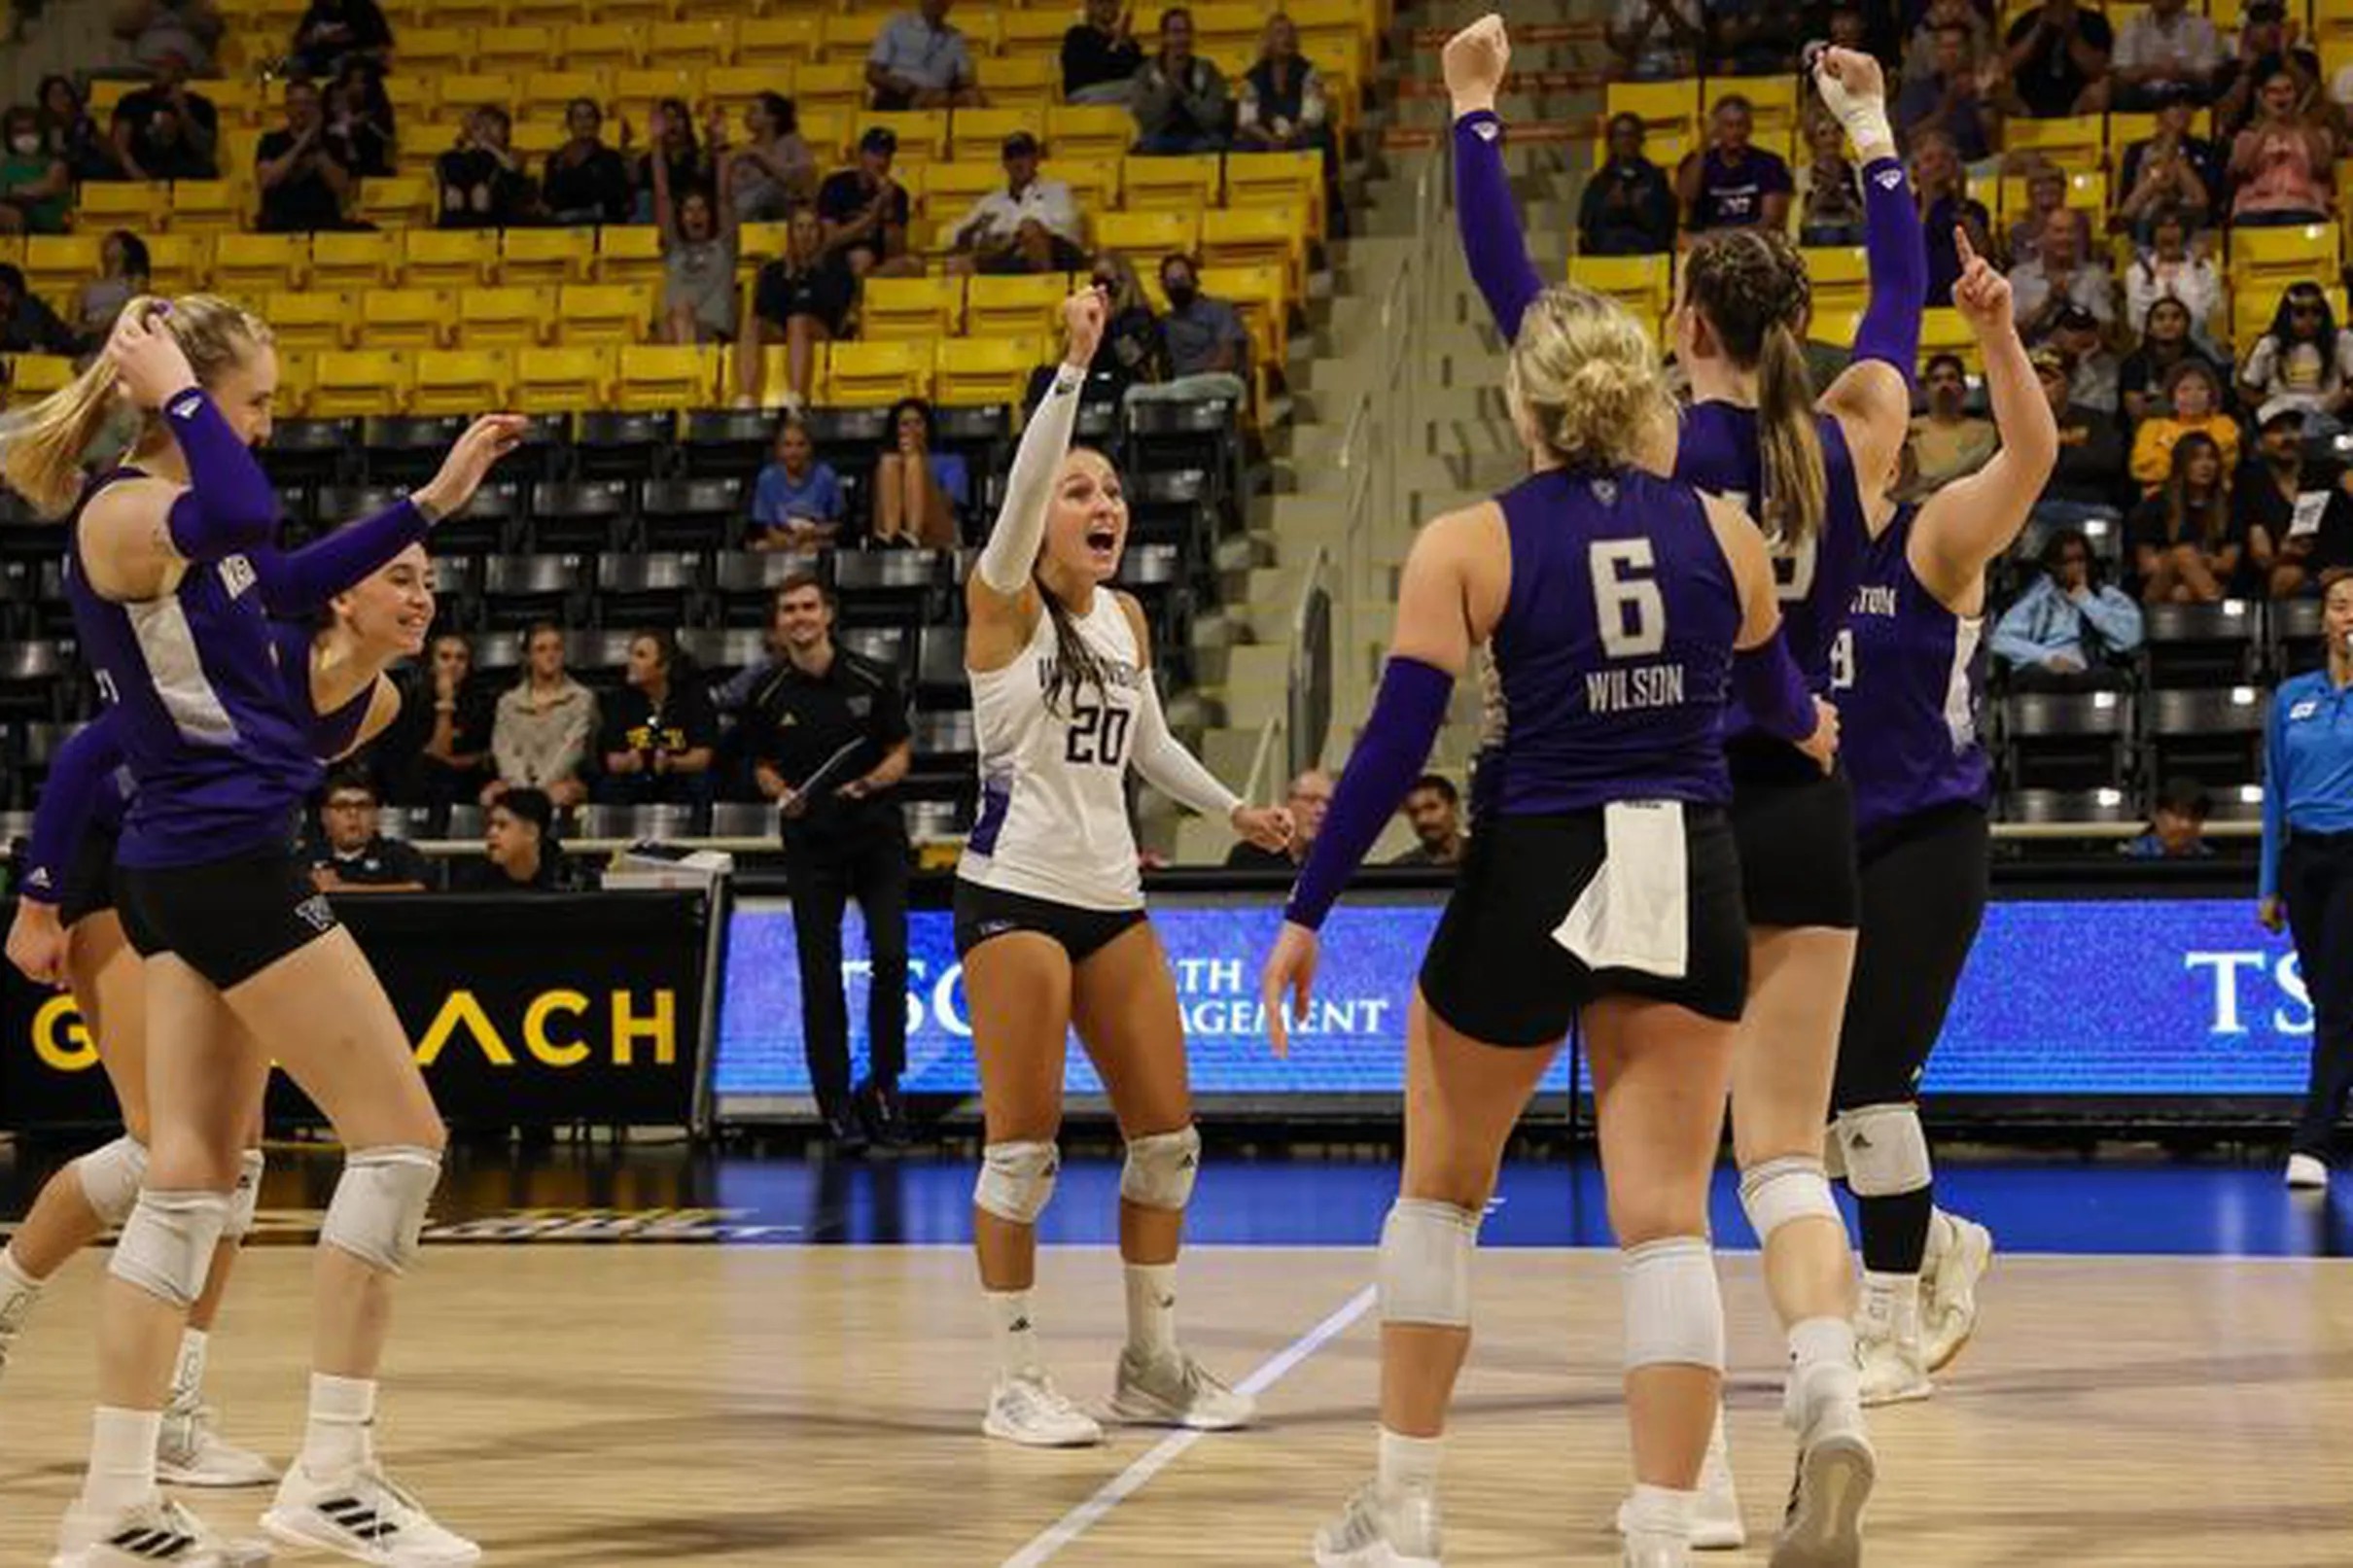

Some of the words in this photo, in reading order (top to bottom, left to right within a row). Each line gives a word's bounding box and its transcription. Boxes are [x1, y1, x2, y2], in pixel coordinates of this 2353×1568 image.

[1589, 539, 1666, 659] 6
[1586, 664, 1684, 713] WILSON
[1065, 706, 1130, 765] 20
[1176, 958, 1242, 993] TH
[2185, 951, 2315, 1033] TS
[32, 994, 99, 1070] G
[412, 990, 675, 1067] ACH
